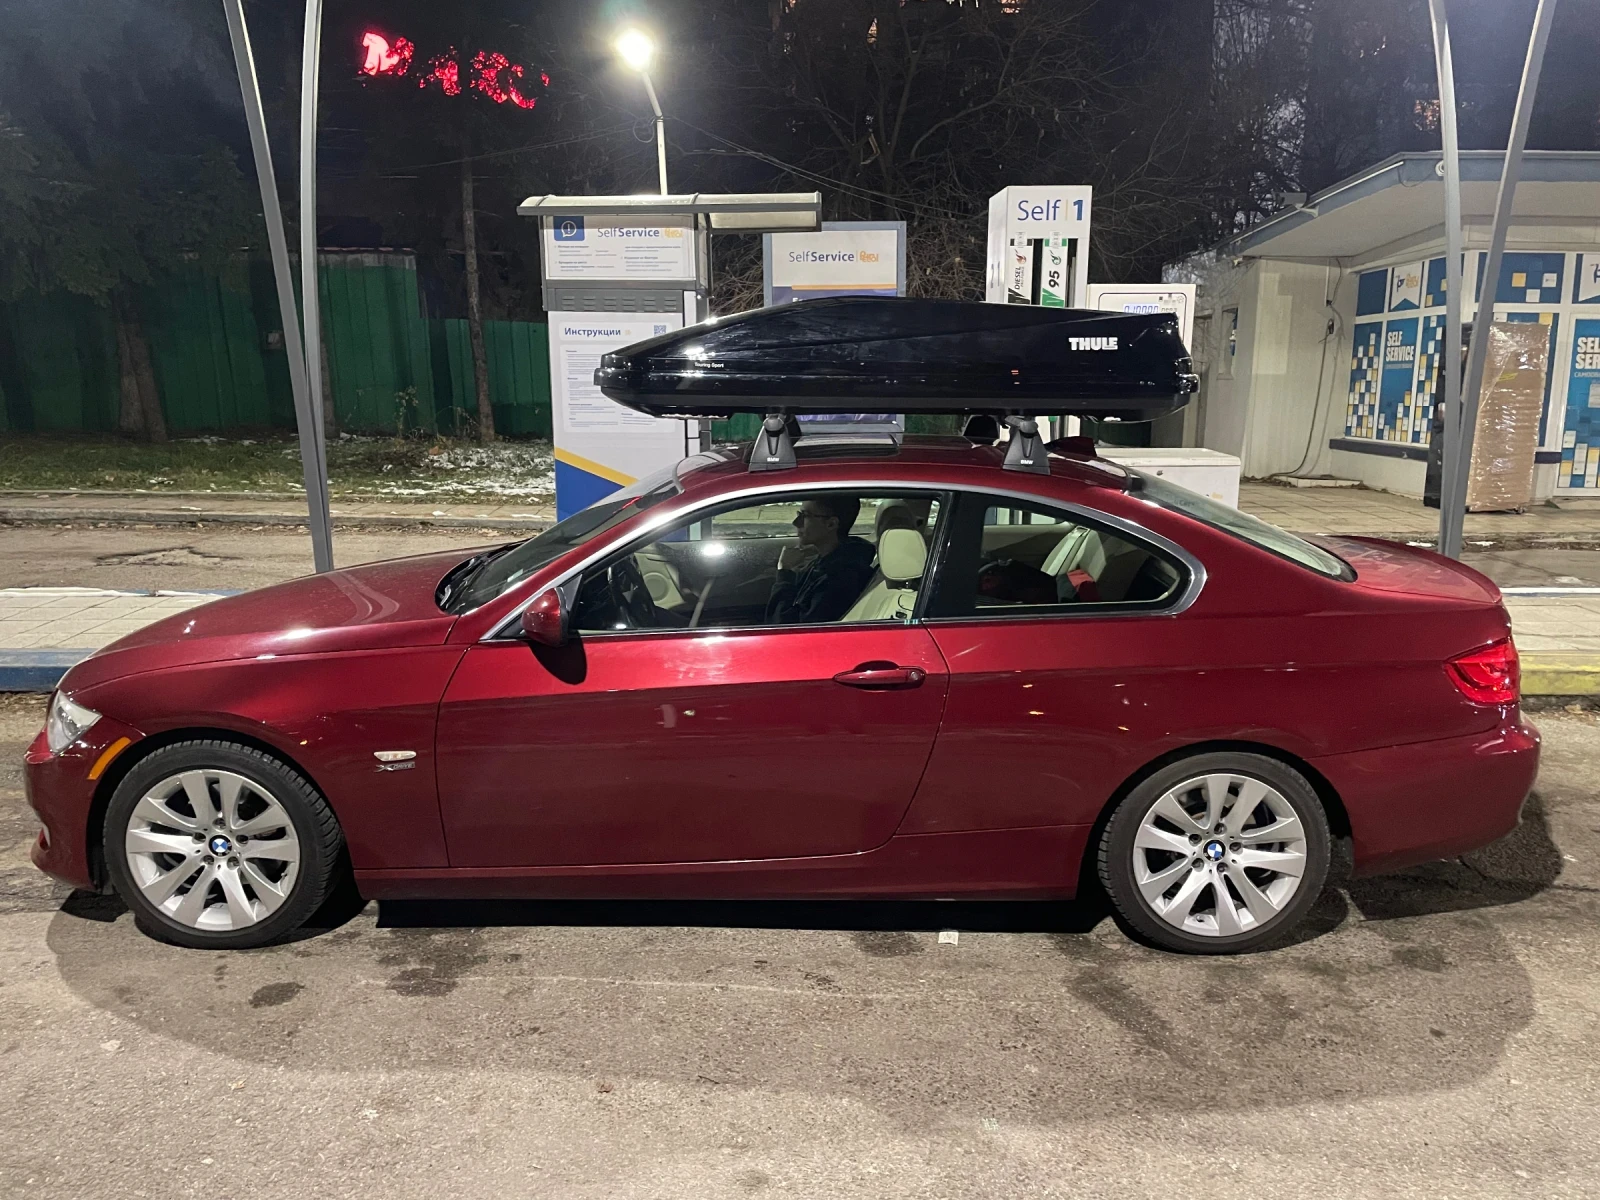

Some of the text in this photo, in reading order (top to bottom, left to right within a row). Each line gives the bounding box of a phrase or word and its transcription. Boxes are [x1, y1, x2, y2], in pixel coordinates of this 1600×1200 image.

[1017, 199, 1083, 221] Self 1
[1048, 270, 1060, 288] 95
[564, 327, 621, 337] Инструкции
[1387, 331, 1403, 347] SELF
[1068, 336, 1118, 351] THULE
[1385, 345, 1415, 362] SERVICE
